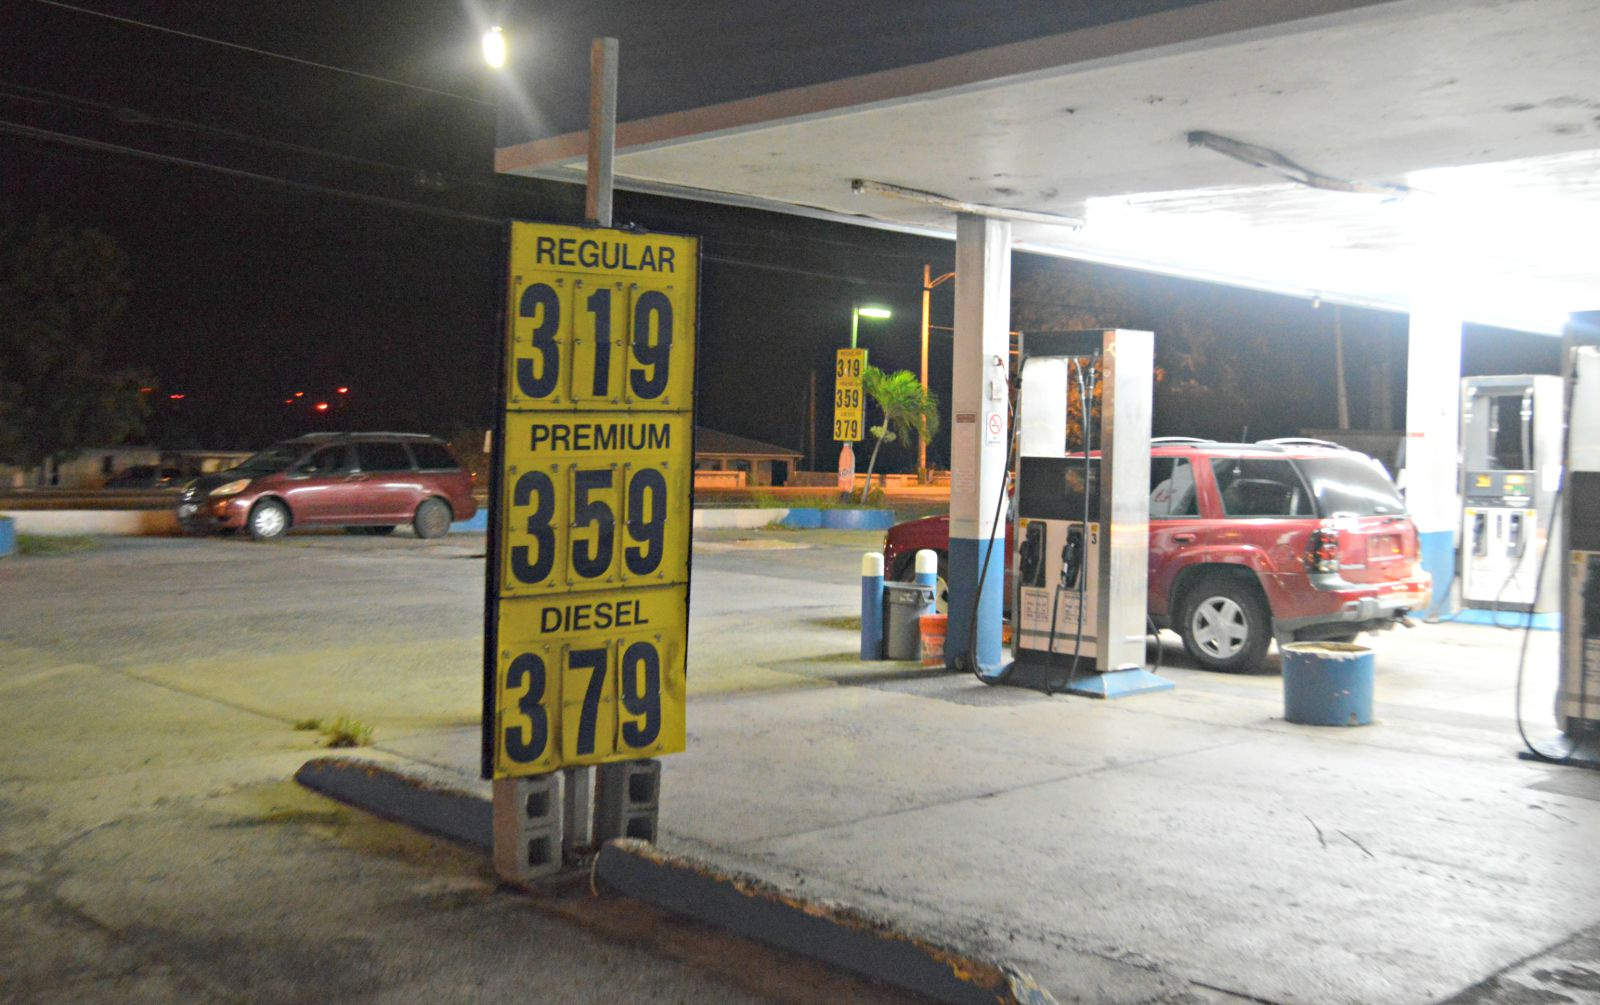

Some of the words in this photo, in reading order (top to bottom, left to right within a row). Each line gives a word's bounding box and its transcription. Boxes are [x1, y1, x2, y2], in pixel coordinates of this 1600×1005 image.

[536, 236, 675, 273] REGULAR
[516, 282, 673, 400] 319
[837, 359, 860, 377] 319
[836, 389, 859, 408] 359
[530, 423, 671, 451] PREMIUM
[835, 419, 858, 438] 379
[511, 467, 667, 584] 359
[540, 600, 649, 633] DIESEL
[504, 641, 662, 764] 379
